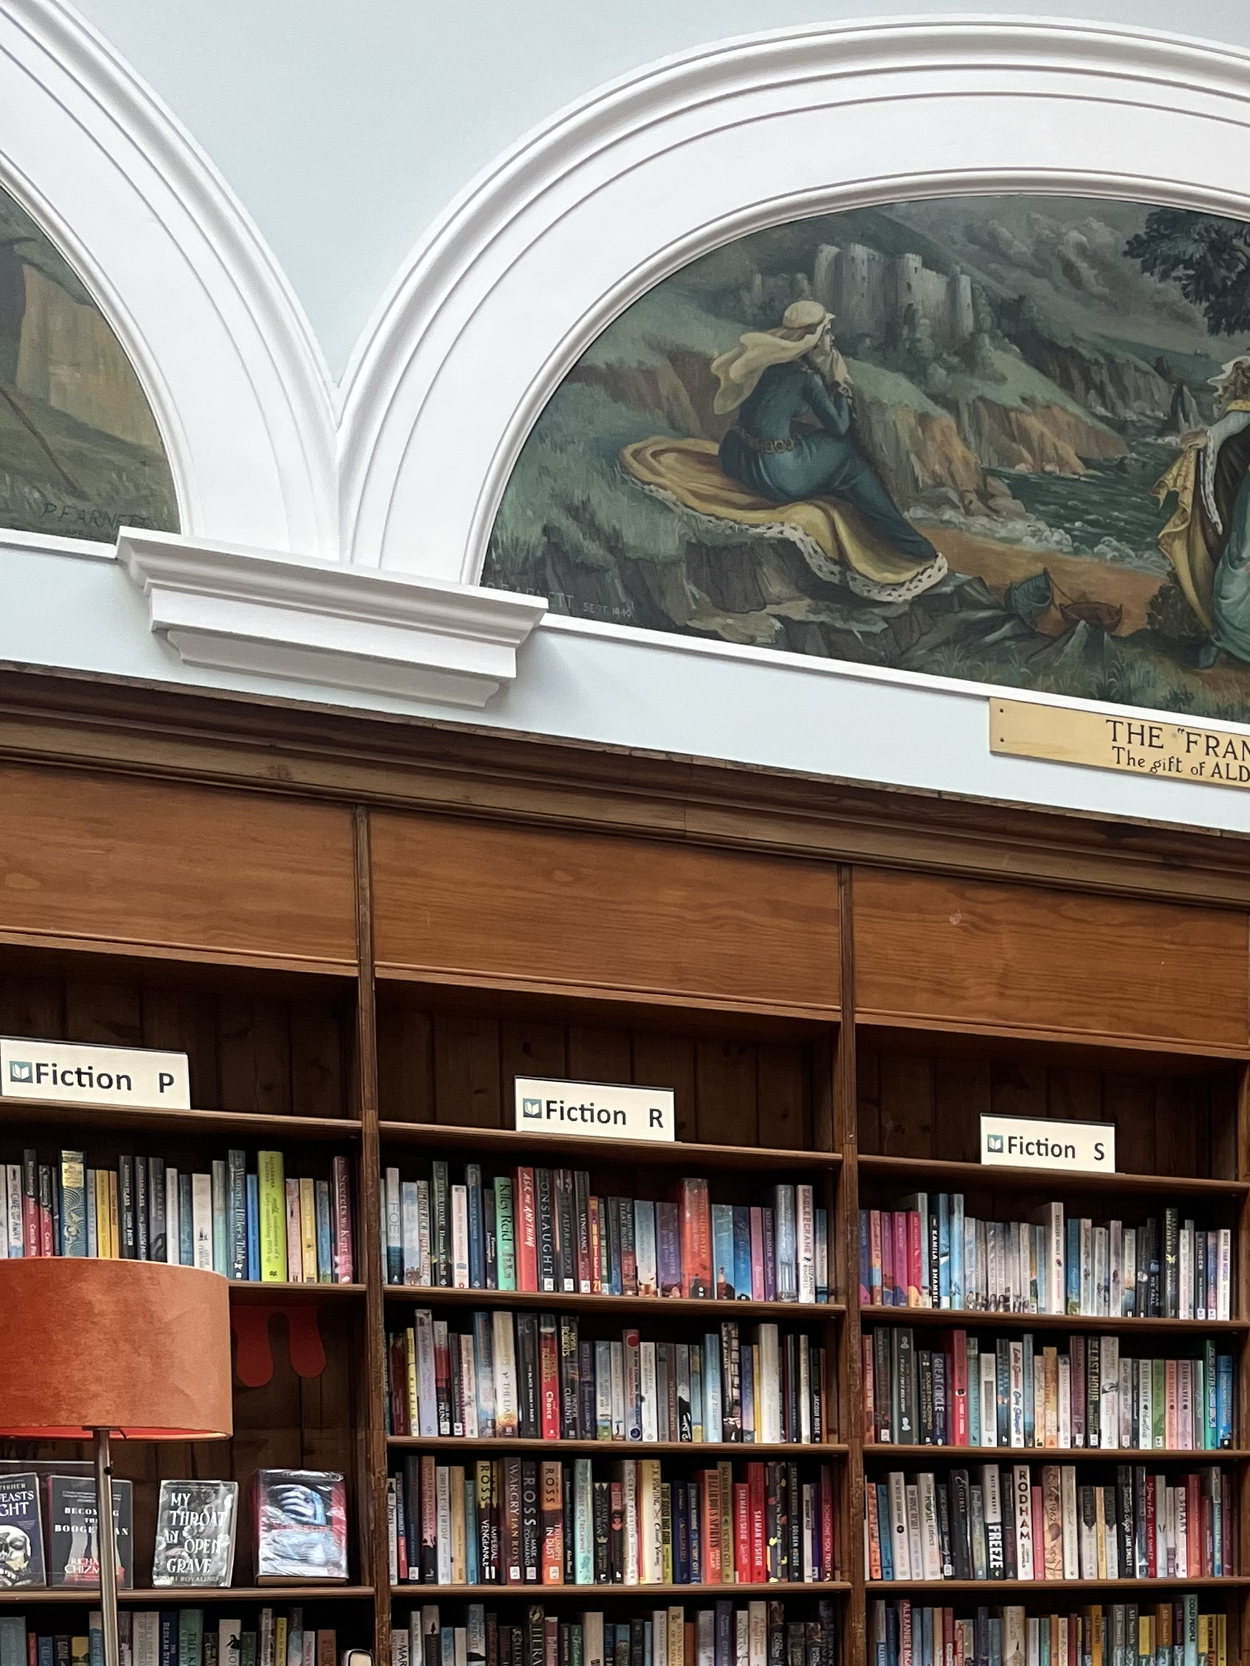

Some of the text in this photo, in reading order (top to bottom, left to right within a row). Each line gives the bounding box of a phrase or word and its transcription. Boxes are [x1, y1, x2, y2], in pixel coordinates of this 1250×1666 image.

[1106, 720, 1164, 748] THE
[1112, 746, 1145, 768] The
[1150, 756, 1183, 774] gift
[1190, 762, 1204, 776] of
[35, 1064, 175, 1093] Fiction P
[546, 1100, 664, 1128] Fiction R
[1008, 1136, 1106, 1161] Fiction S
[234, 1168, 245, 1200] Women
[499, 1183, 512, 1242] Kiley Reid
[523, 1173, 534, 1247] ASK ANYTHING
[540, 1182, 553, 1273] ONSLAUGHT
[580, 1213, 588, 1253] VENGEANCE
[561, 1326, 569, 1357] ROBERTS
[934, 1358, 945, 1411] GREAT CIRCLE
[1089, 1376, 1098, 1401] HOUR
[502, 1383, 512, 1420] THE LIAR
[545, 1391, 554, 1419] Choice
[481, 1465, 489, 1501] ROSS
[545, 1468, 555, 1503] ROSS
[171, 1493, 191, 1506] MY
[524, 1477, 536, 1525] ROSS
[170, 1511, 226, 1527] THROAT
[754, 1511, 762, 1537] SALMAN
[164, 1530, 222, 1553] AN OPEN
[546, 1527, 554, 1559] IN DUST
[554, 1523, 562, 1560] TRIUMPH
[988, 1525, 1003, 1568] FREEZE
[167, 1558, 211, 1574] GRAVE
